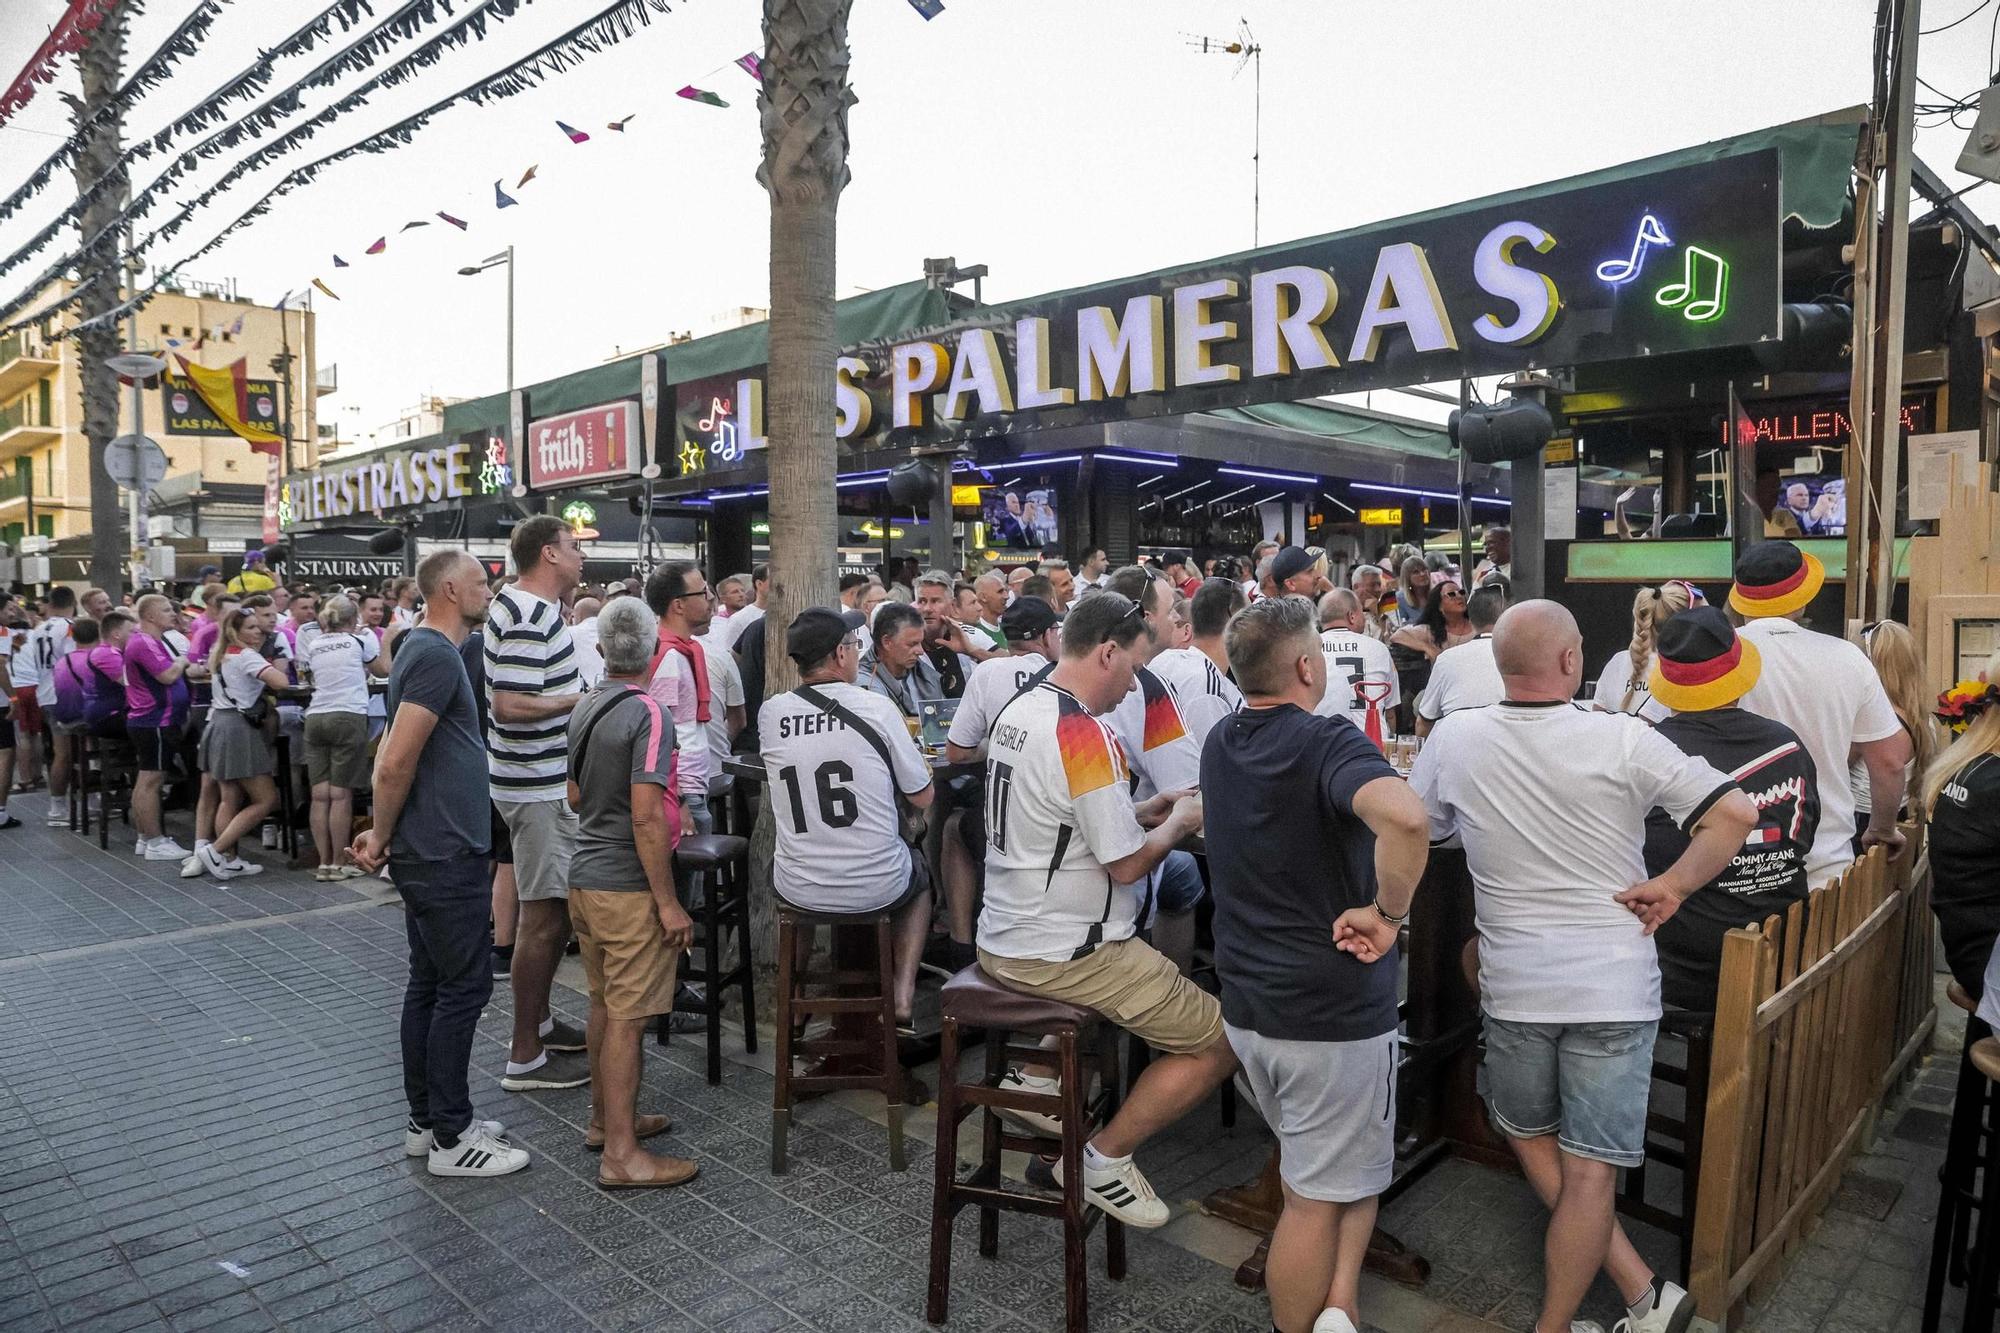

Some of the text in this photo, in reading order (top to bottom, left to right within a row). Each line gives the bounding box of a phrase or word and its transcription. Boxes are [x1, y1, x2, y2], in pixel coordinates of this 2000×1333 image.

[737, 220, 1558, 451] LS PALMERAS
[172, 418, 275, 432] LAS PARAS
[538, 420, 585, 475] früh
[290, 444, 472, 522] BIERSTRASSE
[1625, 679, 1649, 692] Fau
[995, 722, 1028, 753] MUSIALA
[779, 759, 859, 834] 16
[1940, 781, 1969, 802] AND
[1765, 847, 1795, 861] JEANS
[1718, 879, 1754, 888] MANHATTAN
